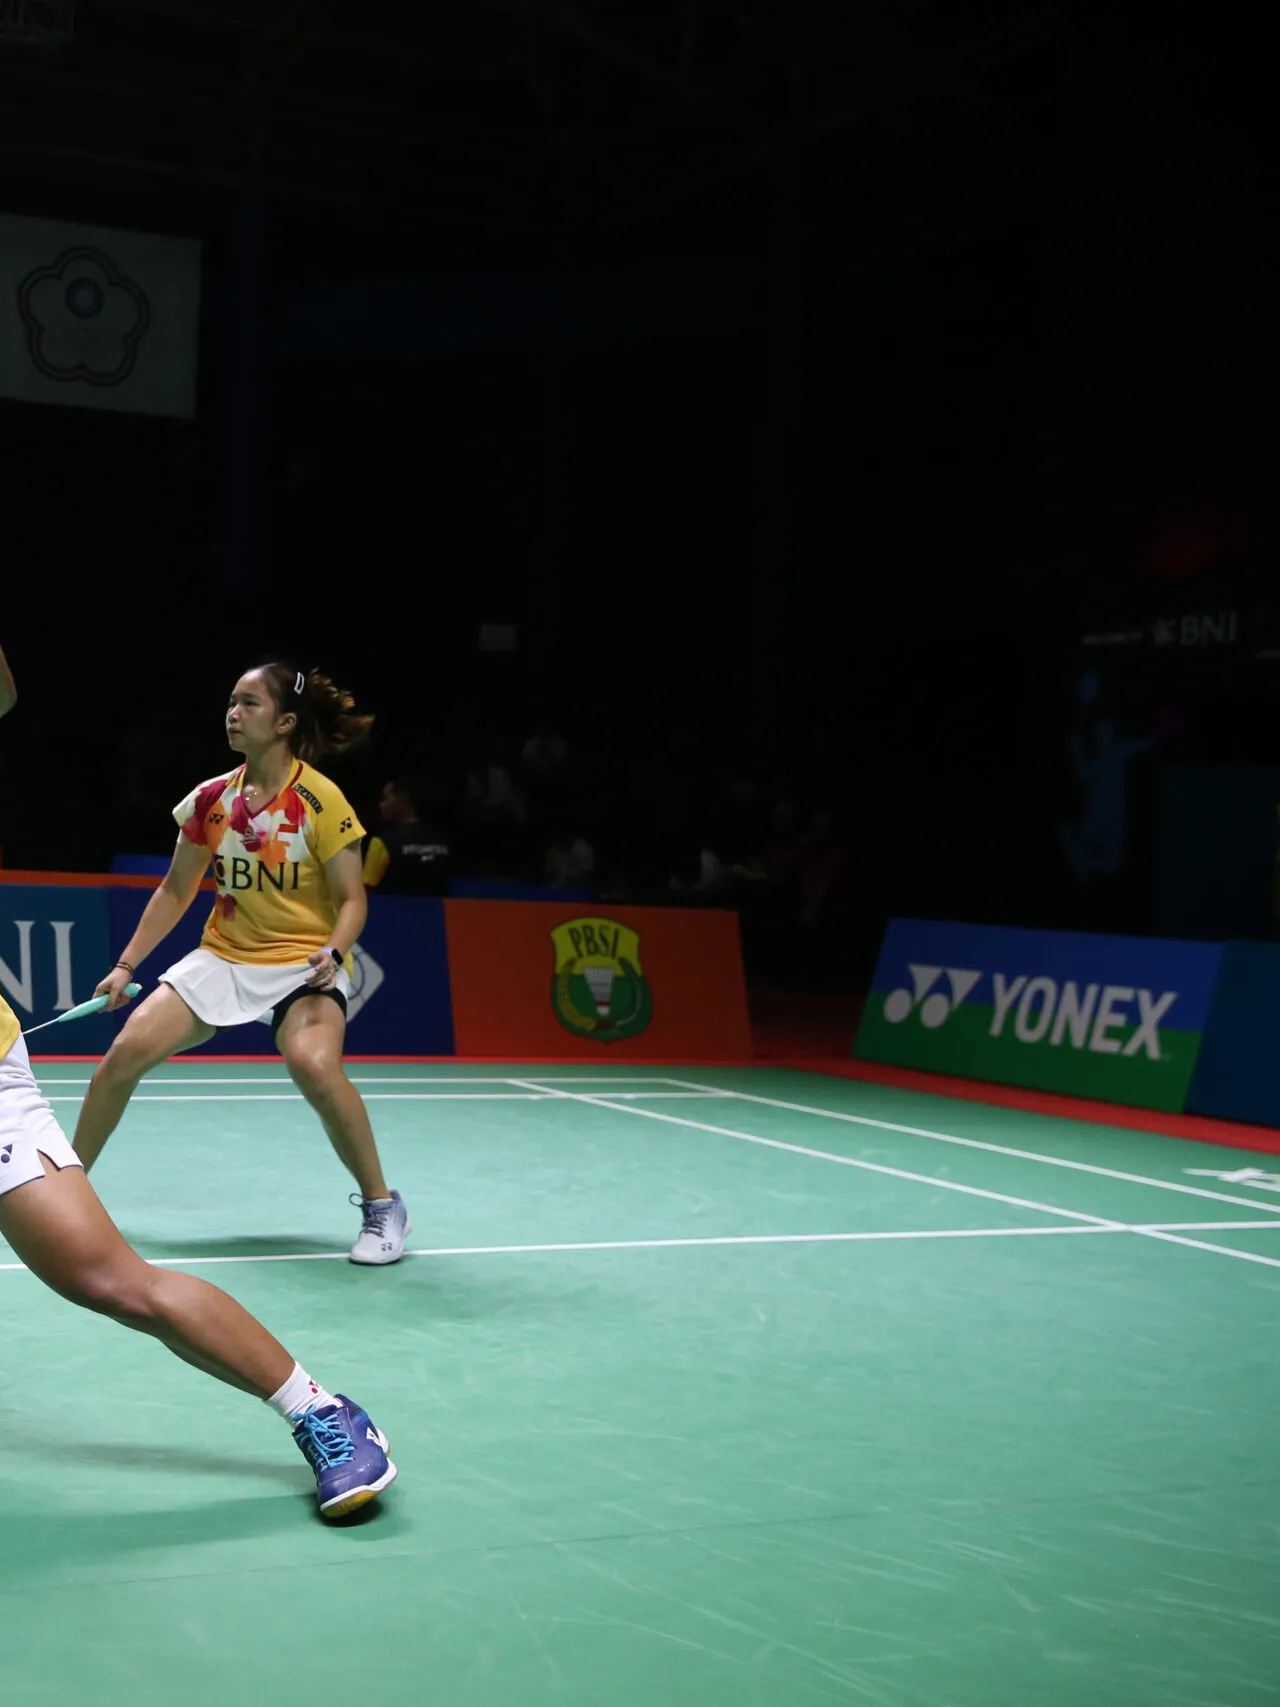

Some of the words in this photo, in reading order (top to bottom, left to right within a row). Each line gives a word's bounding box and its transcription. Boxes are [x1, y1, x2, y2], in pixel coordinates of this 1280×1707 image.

[1181, 611, 1239, 647] BNI
[231, 856, 300, 892] BNI
[567, 925, 619, 960] PBSI
[987, 972, 1180, 1061] YONEX
